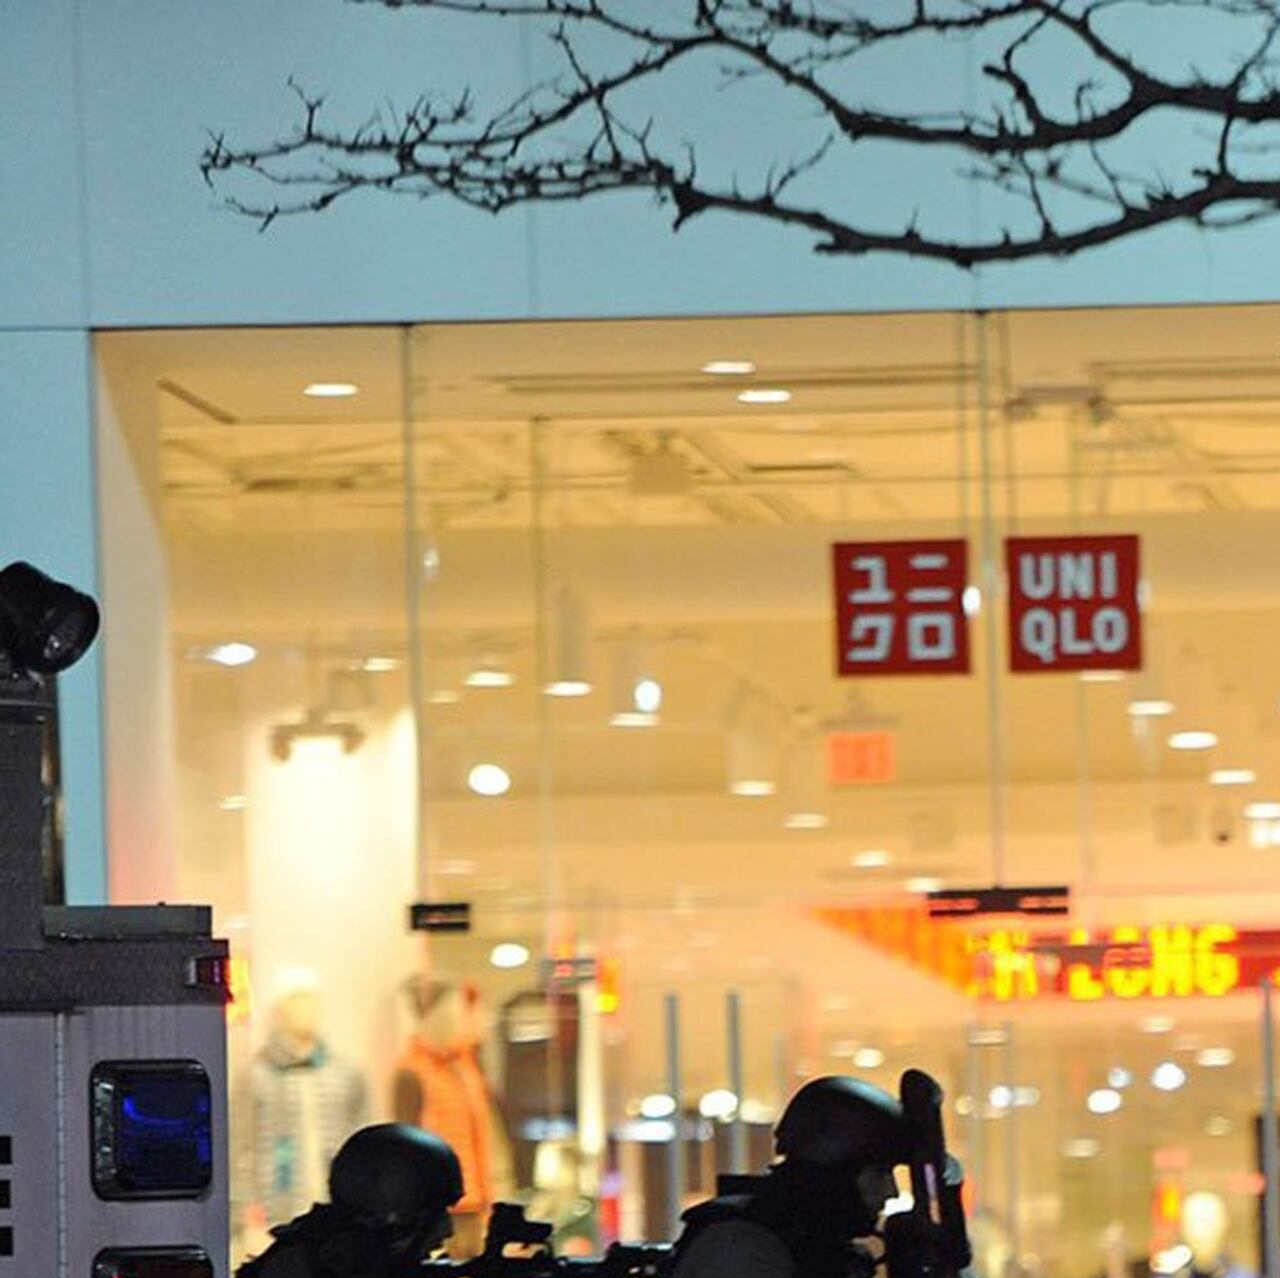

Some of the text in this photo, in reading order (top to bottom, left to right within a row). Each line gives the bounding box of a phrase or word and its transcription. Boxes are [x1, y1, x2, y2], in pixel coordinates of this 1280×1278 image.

[847, 553, 955, 605] ユニ
[1018, 551, 1118, 600] UNI
[846, 611, 956, 663] クロ
[1020, 606, 1129, 664] QLO
